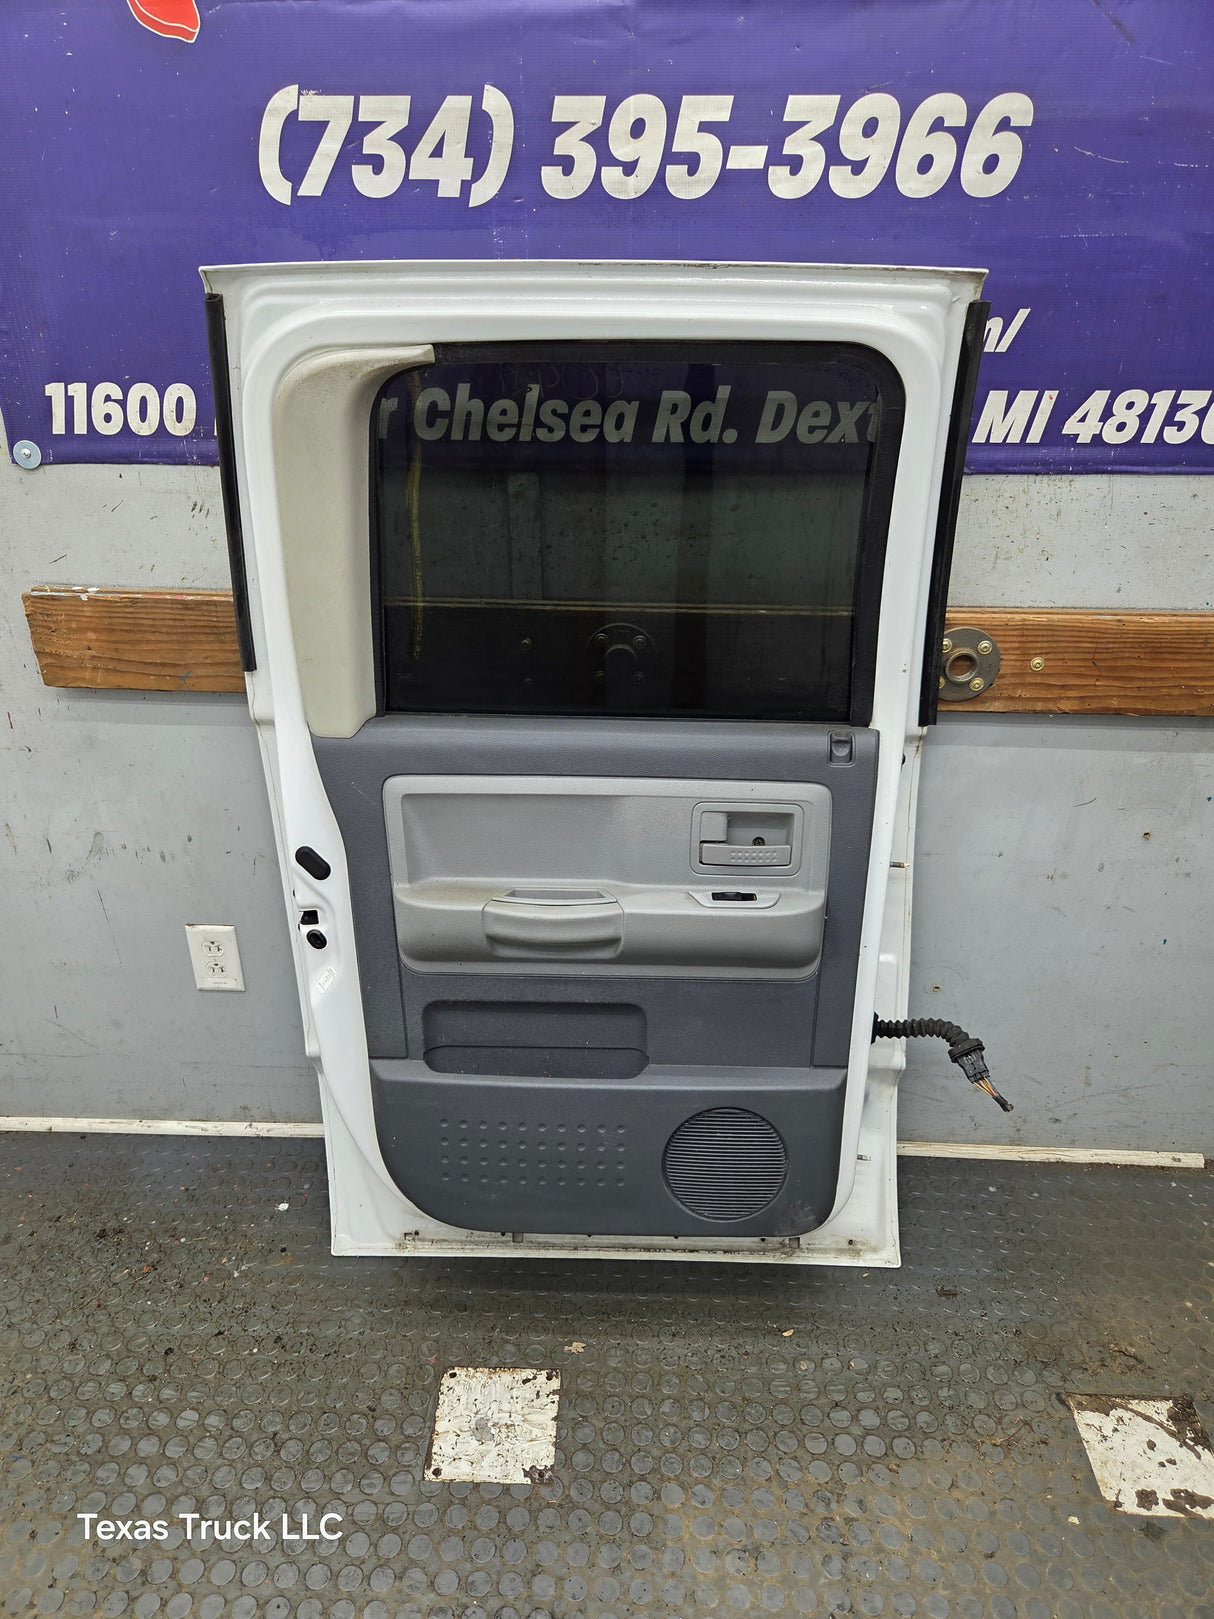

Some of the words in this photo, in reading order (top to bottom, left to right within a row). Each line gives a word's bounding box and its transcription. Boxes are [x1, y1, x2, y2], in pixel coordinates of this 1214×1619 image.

[259, 84, 514, 207] (734)
[541, 93, 1033, 199] 395-3966
[45, 382, 196, 436] 11600
[415, 384, 637, 442] Chelsea
[652, 386, 737, 443] Rd.
[972, 391, 1059, 443] MI
